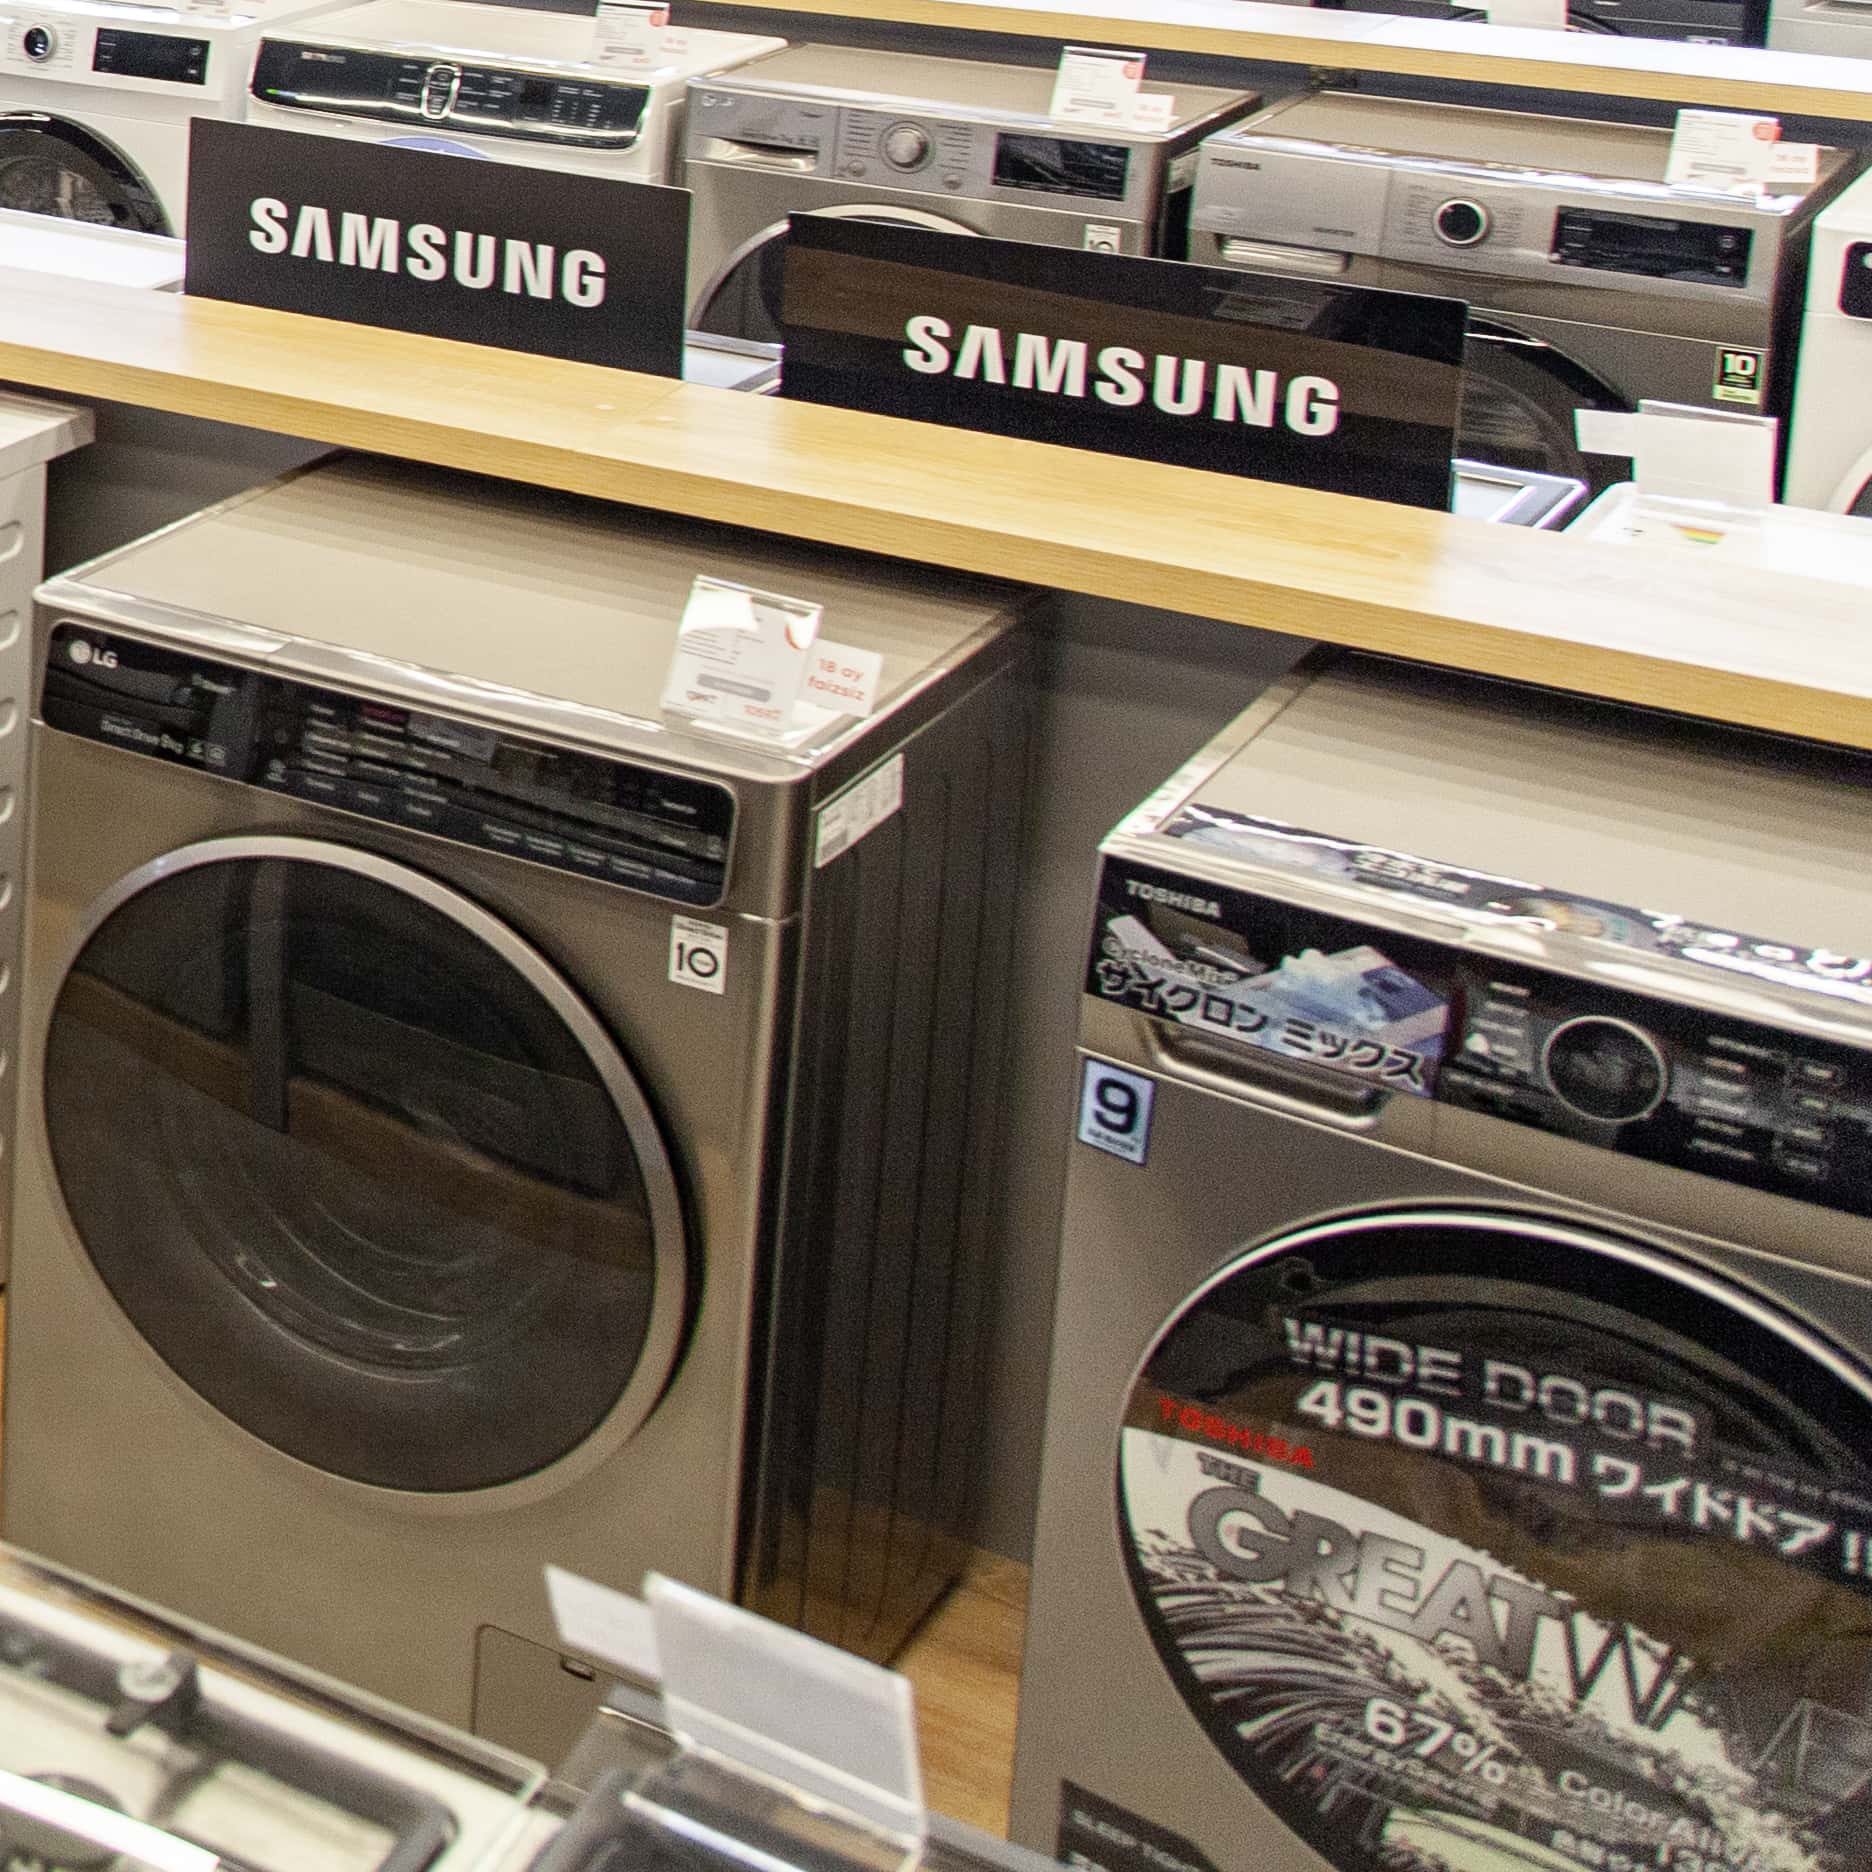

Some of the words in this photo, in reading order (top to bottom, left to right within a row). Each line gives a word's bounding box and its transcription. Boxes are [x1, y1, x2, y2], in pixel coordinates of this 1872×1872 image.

[248, 196, 607, 309] SAMSUNG
[902, 314, 1342, 438] SAMSUNG
[1724, 353, 1757, 376] 10
[92, 647, 119, 669] LG
[807, 675, 865, 702] faizsiz
[818, 657, 837, 674] 18
[840, 667, 865, 682] ay
[1125, 879, 1223, 918] TOSHIBA
[677, 941, 718, 978] 10
[1097, 956, 1268, 1034] サイクロン
[1281, 1016, 1425, 1090] ミックス
[1094, 1076, 1140, 1135] 9
[1285, 1316, 1464, 1397] WIDE
[1482, 1358, 1700, 1460] DOOR
[1158, 1396, 1315, 1470] TOSHIBA
[1297, 1380, 1576, 1486] 490mm
[1188, 1485, 1569, 1680] GREAT
[1365, 1696, 1507, 1785] 67%
